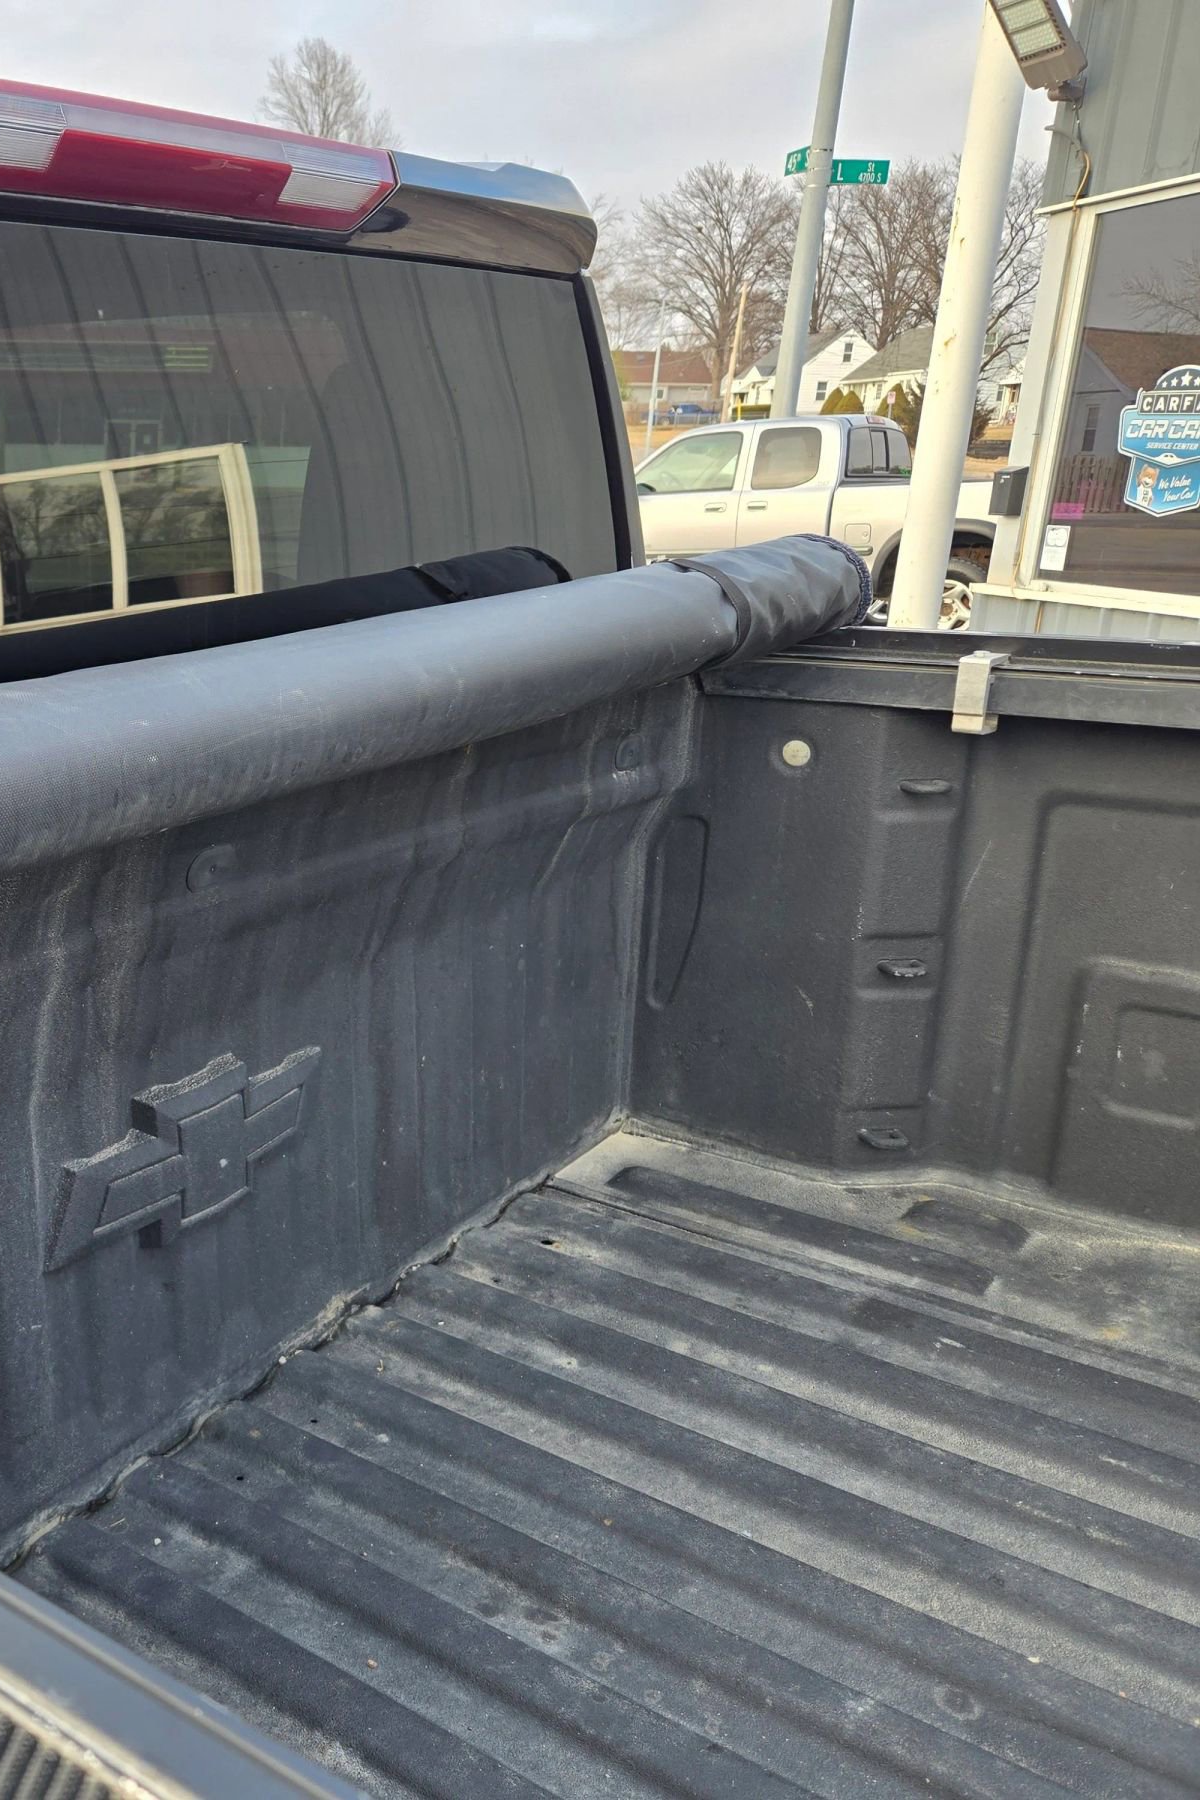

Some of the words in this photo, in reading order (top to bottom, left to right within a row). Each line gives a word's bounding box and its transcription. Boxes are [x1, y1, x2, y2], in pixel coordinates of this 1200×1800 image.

[837, 163, 844, 181] L
[867, 162, 875, 172] St
[876, 172, 882, 183] S
[1126, 419, 1168, 439] CAR
[1158, 478, 1170, 490] We
[1170, 474, 1192, 489] Value
[1163, 490, 1180, 502] Your
[1180, 488, 1195, 500] Car
